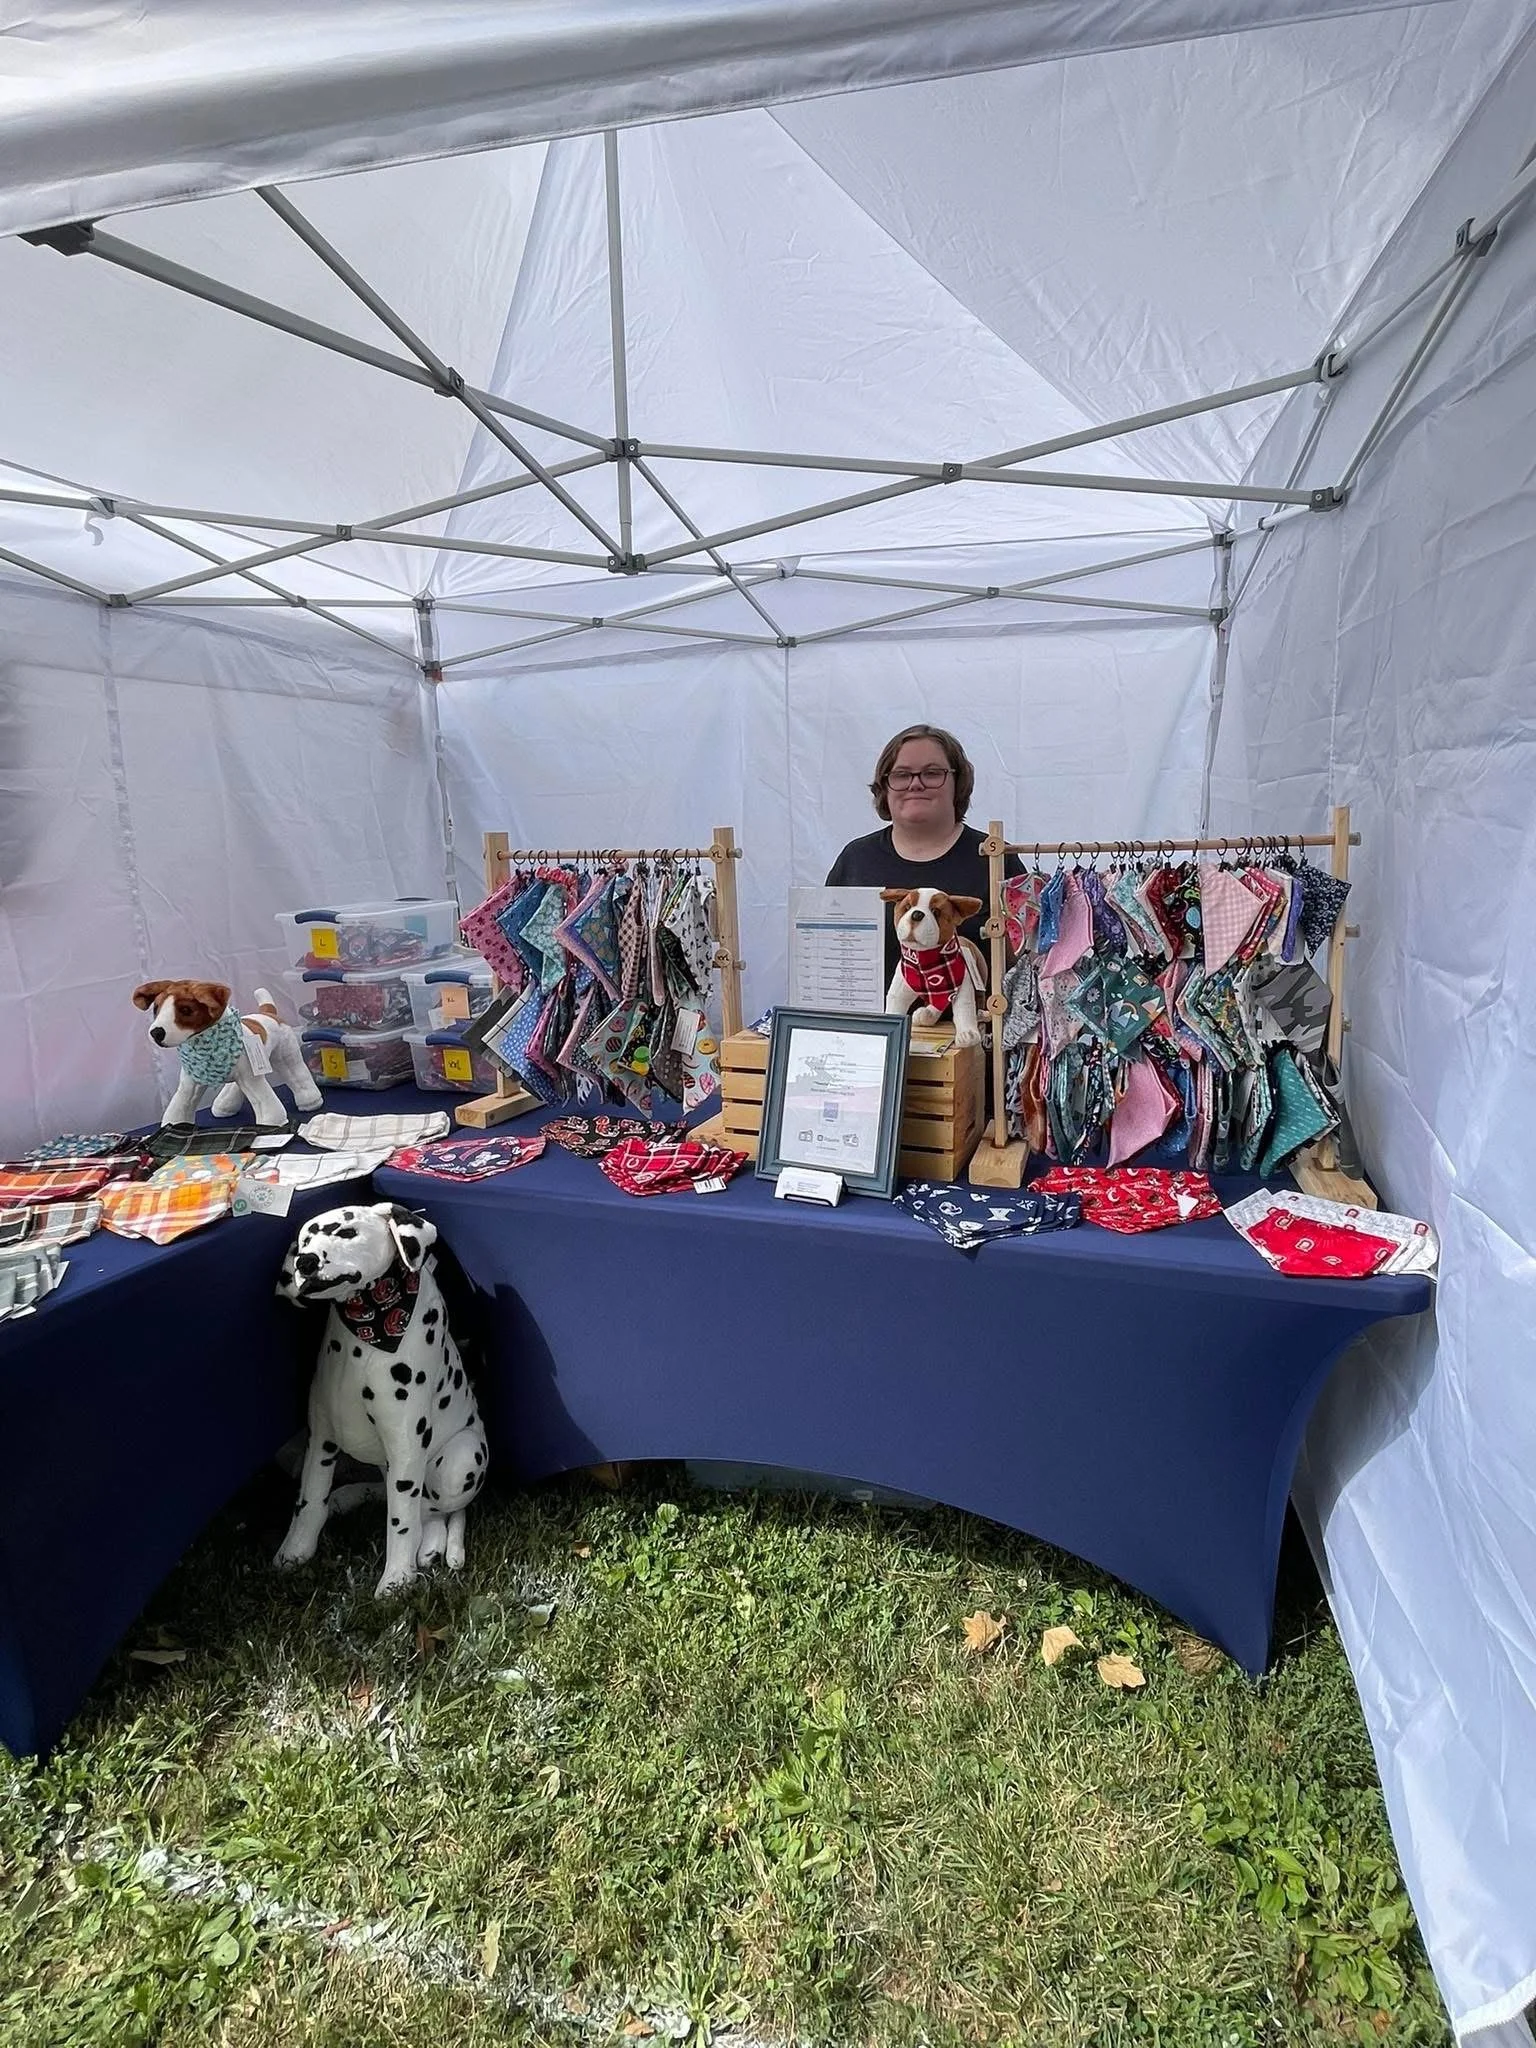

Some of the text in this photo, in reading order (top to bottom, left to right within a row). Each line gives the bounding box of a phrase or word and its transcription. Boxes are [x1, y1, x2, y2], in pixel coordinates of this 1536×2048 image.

[989, 841, 997, 852] S
[990, 922, 1000, 931] M
[991, 999, 999, 1009] L
[329, 1054, 338, 1070] S
